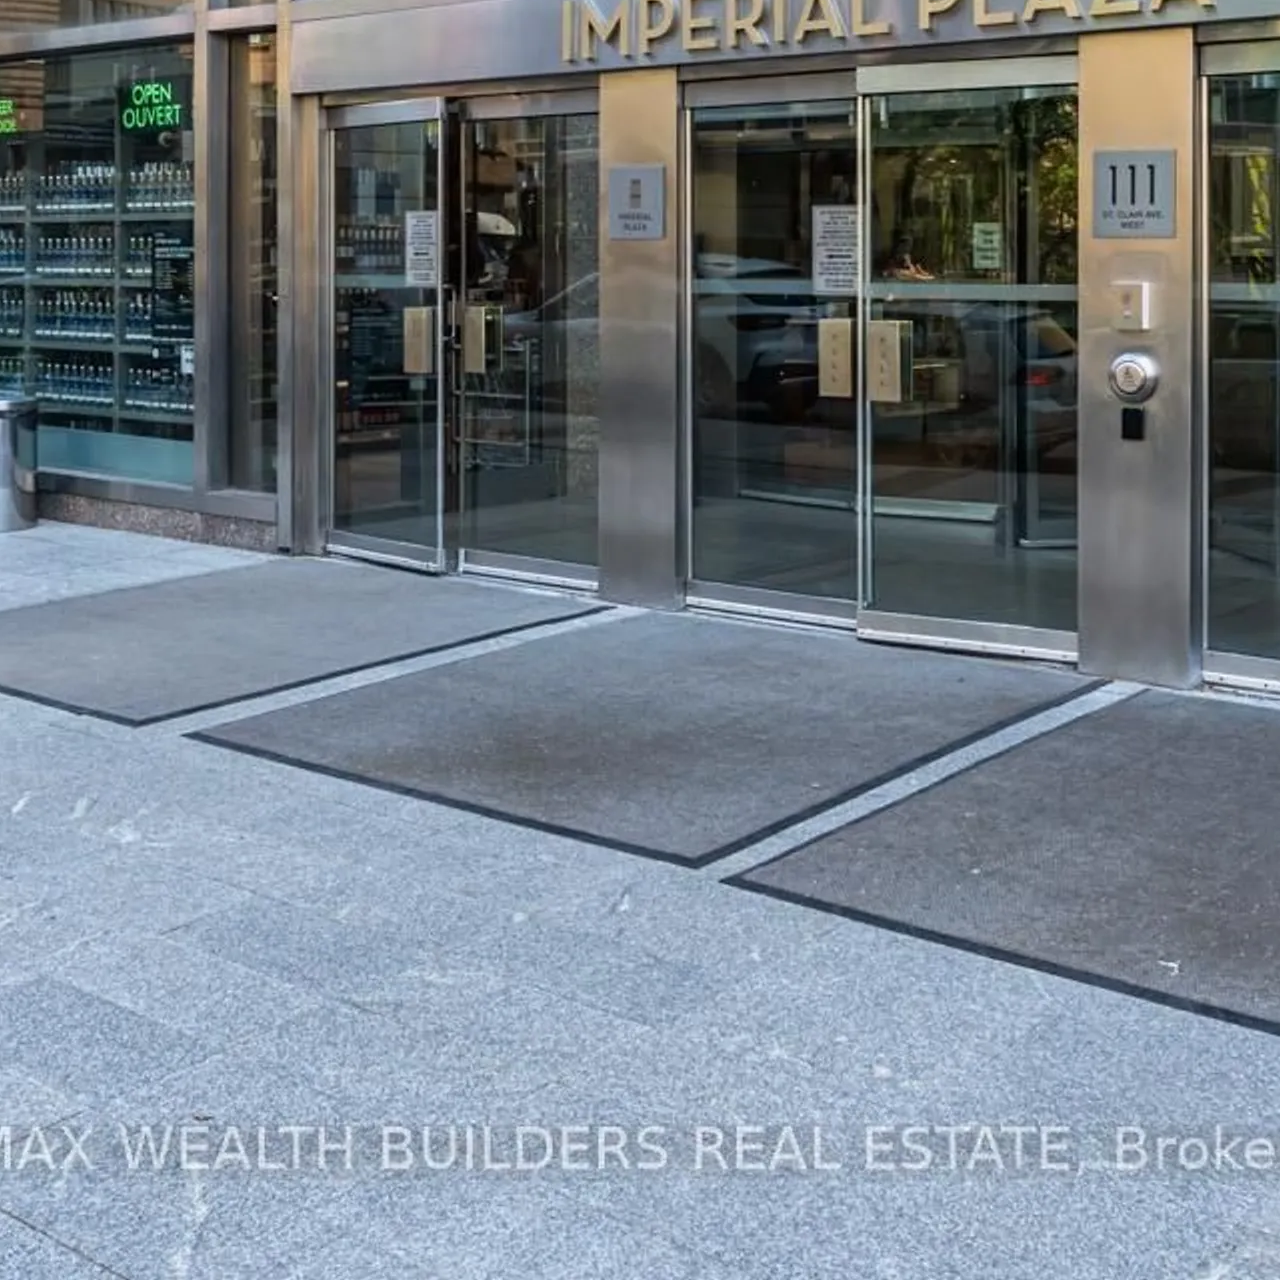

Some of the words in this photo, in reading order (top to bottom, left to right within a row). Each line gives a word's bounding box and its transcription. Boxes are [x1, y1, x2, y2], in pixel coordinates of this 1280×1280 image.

[131, 82, 173, 106] OPEN
[122, 104, 182, 130] OUVERT
[1108, 164, 1156, 206] 111
